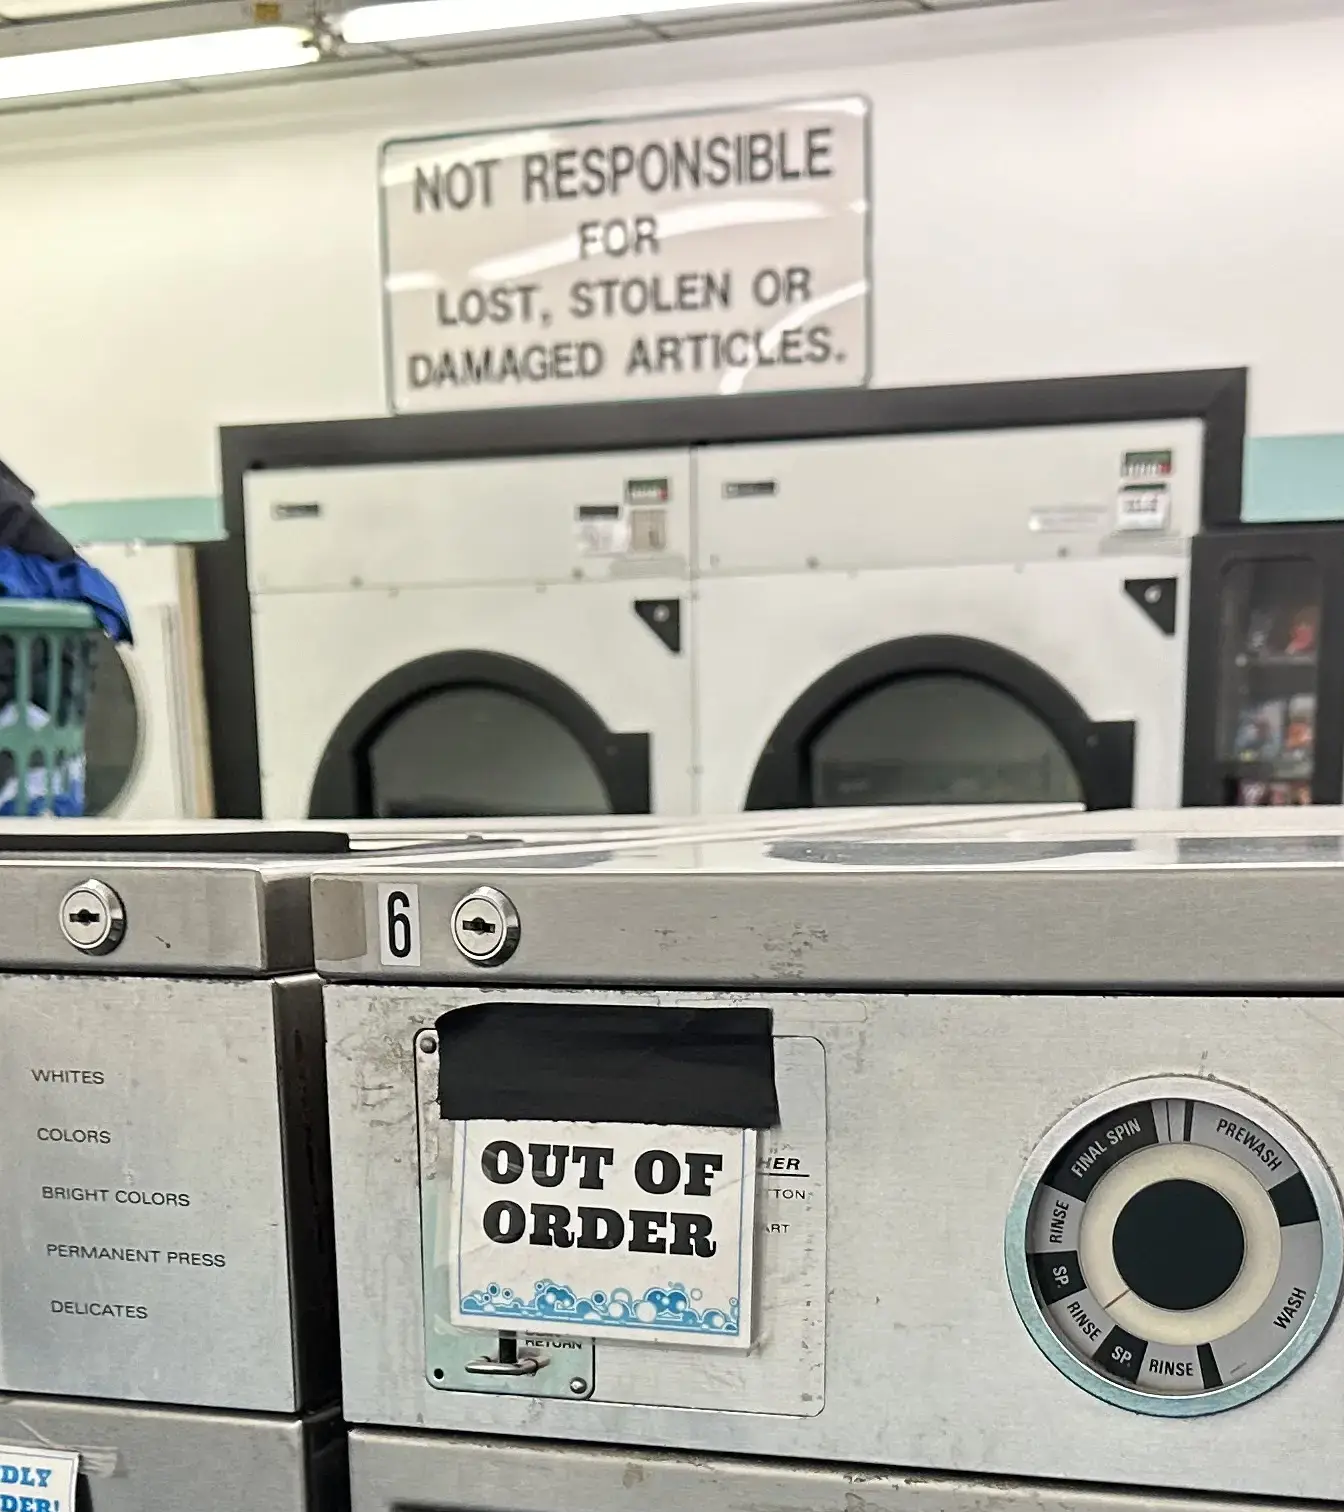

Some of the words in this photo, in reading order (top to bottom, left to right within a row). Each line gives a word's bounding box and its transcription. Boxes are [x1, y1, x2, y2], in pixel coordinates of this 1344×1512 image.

[413, 159, 499, 213] NOT
[524, 127, 834, 202] RESPONSIBLE
[578, 217, 660, 258] FOR
[437, 283, 552, 327] LOST,
[570, 272, 732, 318] STOLEN
[753, 268, 812, 304] OR
[407, 342, 604, 389] DAMAGED
[626, 326, 848, 375] ARTICLES.
[385, 890, 412, 958] 6
[31, 1069, 105, 1085] WHITES
[37, 1128, 111, 1144] COLORS
[1071, 1140, 1108, 1179] FINAL
[1108, 1117, 1142, 1145] SPIN
[1216, 1118, 1283, 1172] PREWASH
[481, 1140, 614, 1190] OUT
[634, 1148, 724, 1197] OF
[42, 1186, 108, 1203] BRIGHT
[115, 1190, 190, 1207] COLORS
[483, 1200, 718, 1259] ORDER
[1049, 1199, 1070, 1244] RINSE
[47, 1244, 160, 1264] PERMANENT
[167, 1252, 226, 1268] PRESS
[50, 1300, 148, 1319] DELICATES
[1067, 1300, 1102, 1342] RINSE
[1273, 1286, 1307, 1330] WASH
[1149, 1358, 1194, 1377] RINSE
